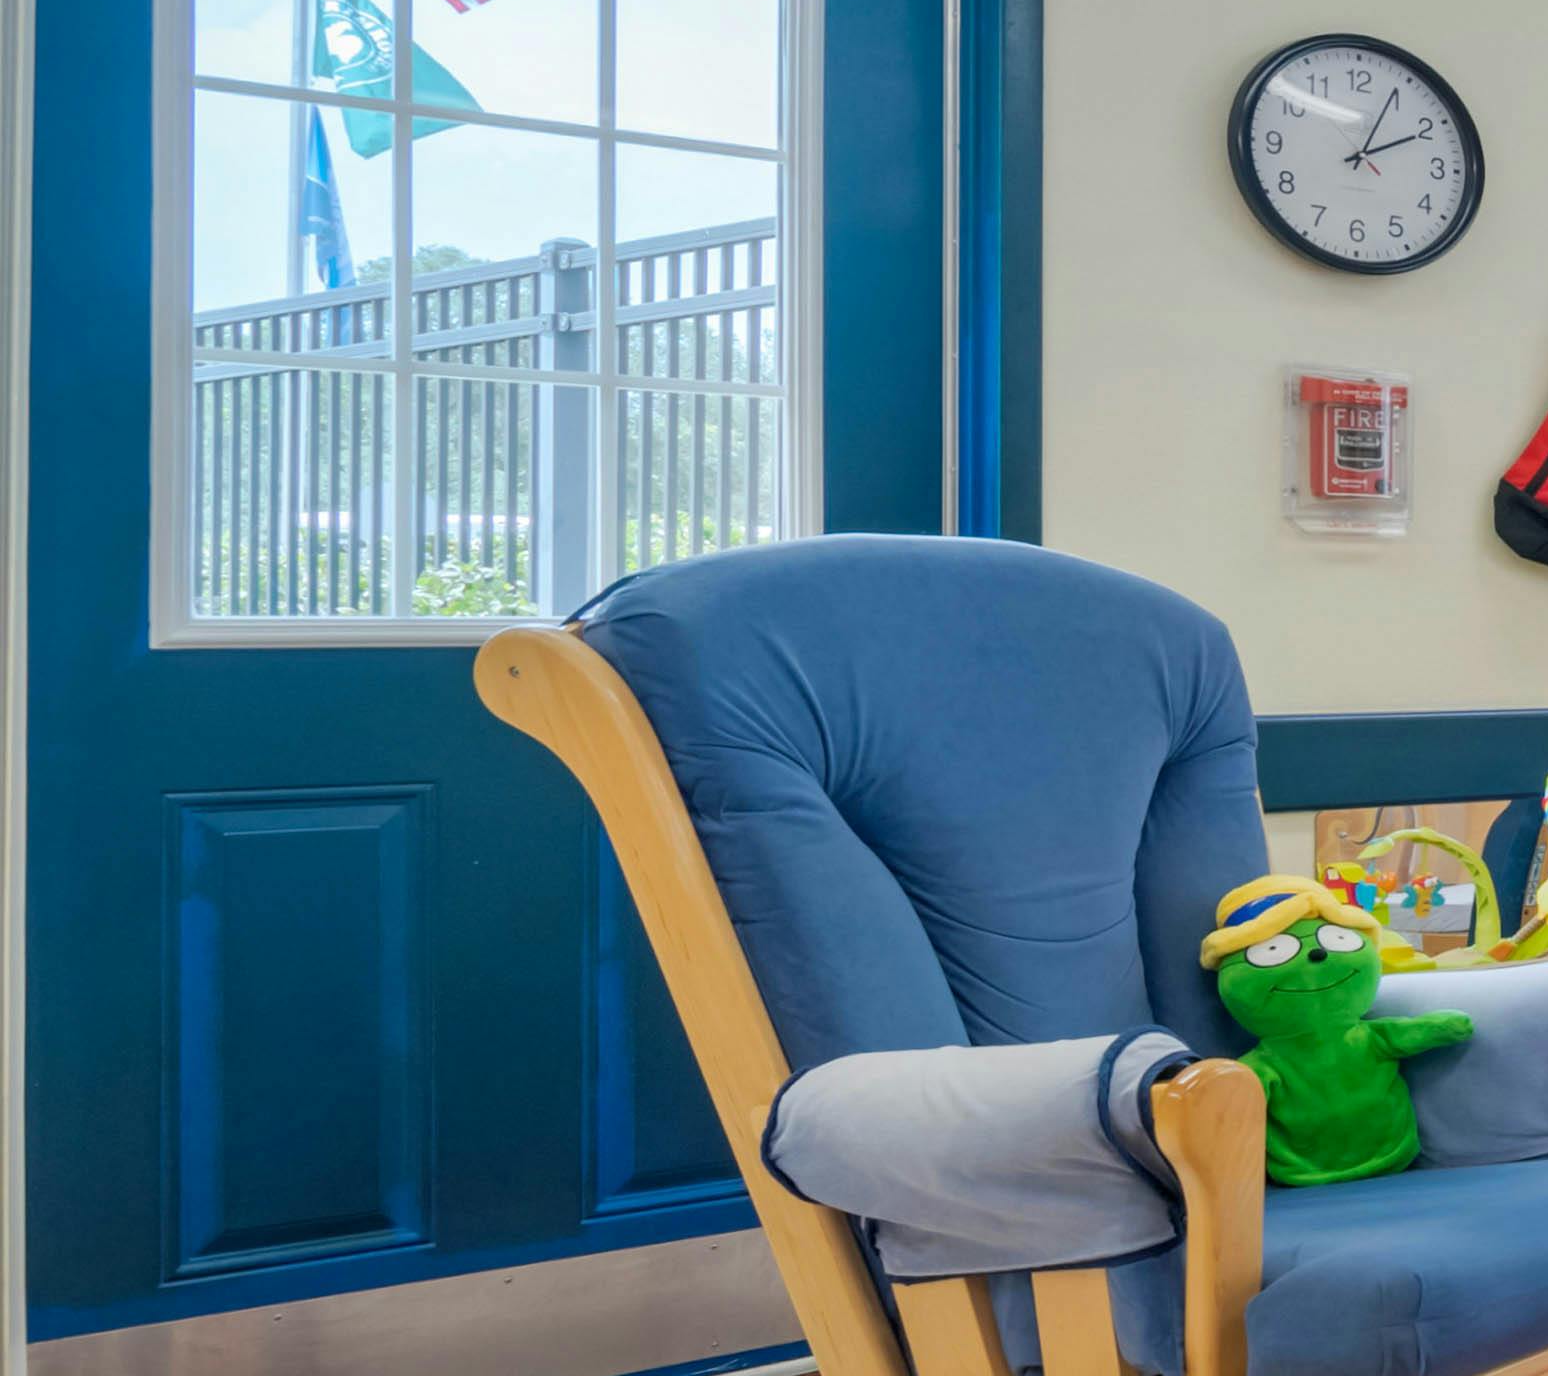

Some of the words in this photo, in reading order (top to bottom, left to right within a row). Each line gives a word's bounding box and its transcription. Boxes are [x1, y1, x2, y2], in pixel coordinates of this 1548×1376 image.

[1307, 74, 1329, 98] 11
[1347, 69, 1372, 93] 12
[1418, 117, 1434, 141] 2
[1265, 131, 1283, 154] 9
[1430, 157, 1446, 180] 3
[1278, 171, 1295, 195] 8
[1417, 193, 1432, 214] 4
[1310, 204, 1327, 228] 7
[1388, 215, 1404, 238] 5
[1350, 220, 1365, 243] 6
[1333, 408, 1386, 429] FIRE
